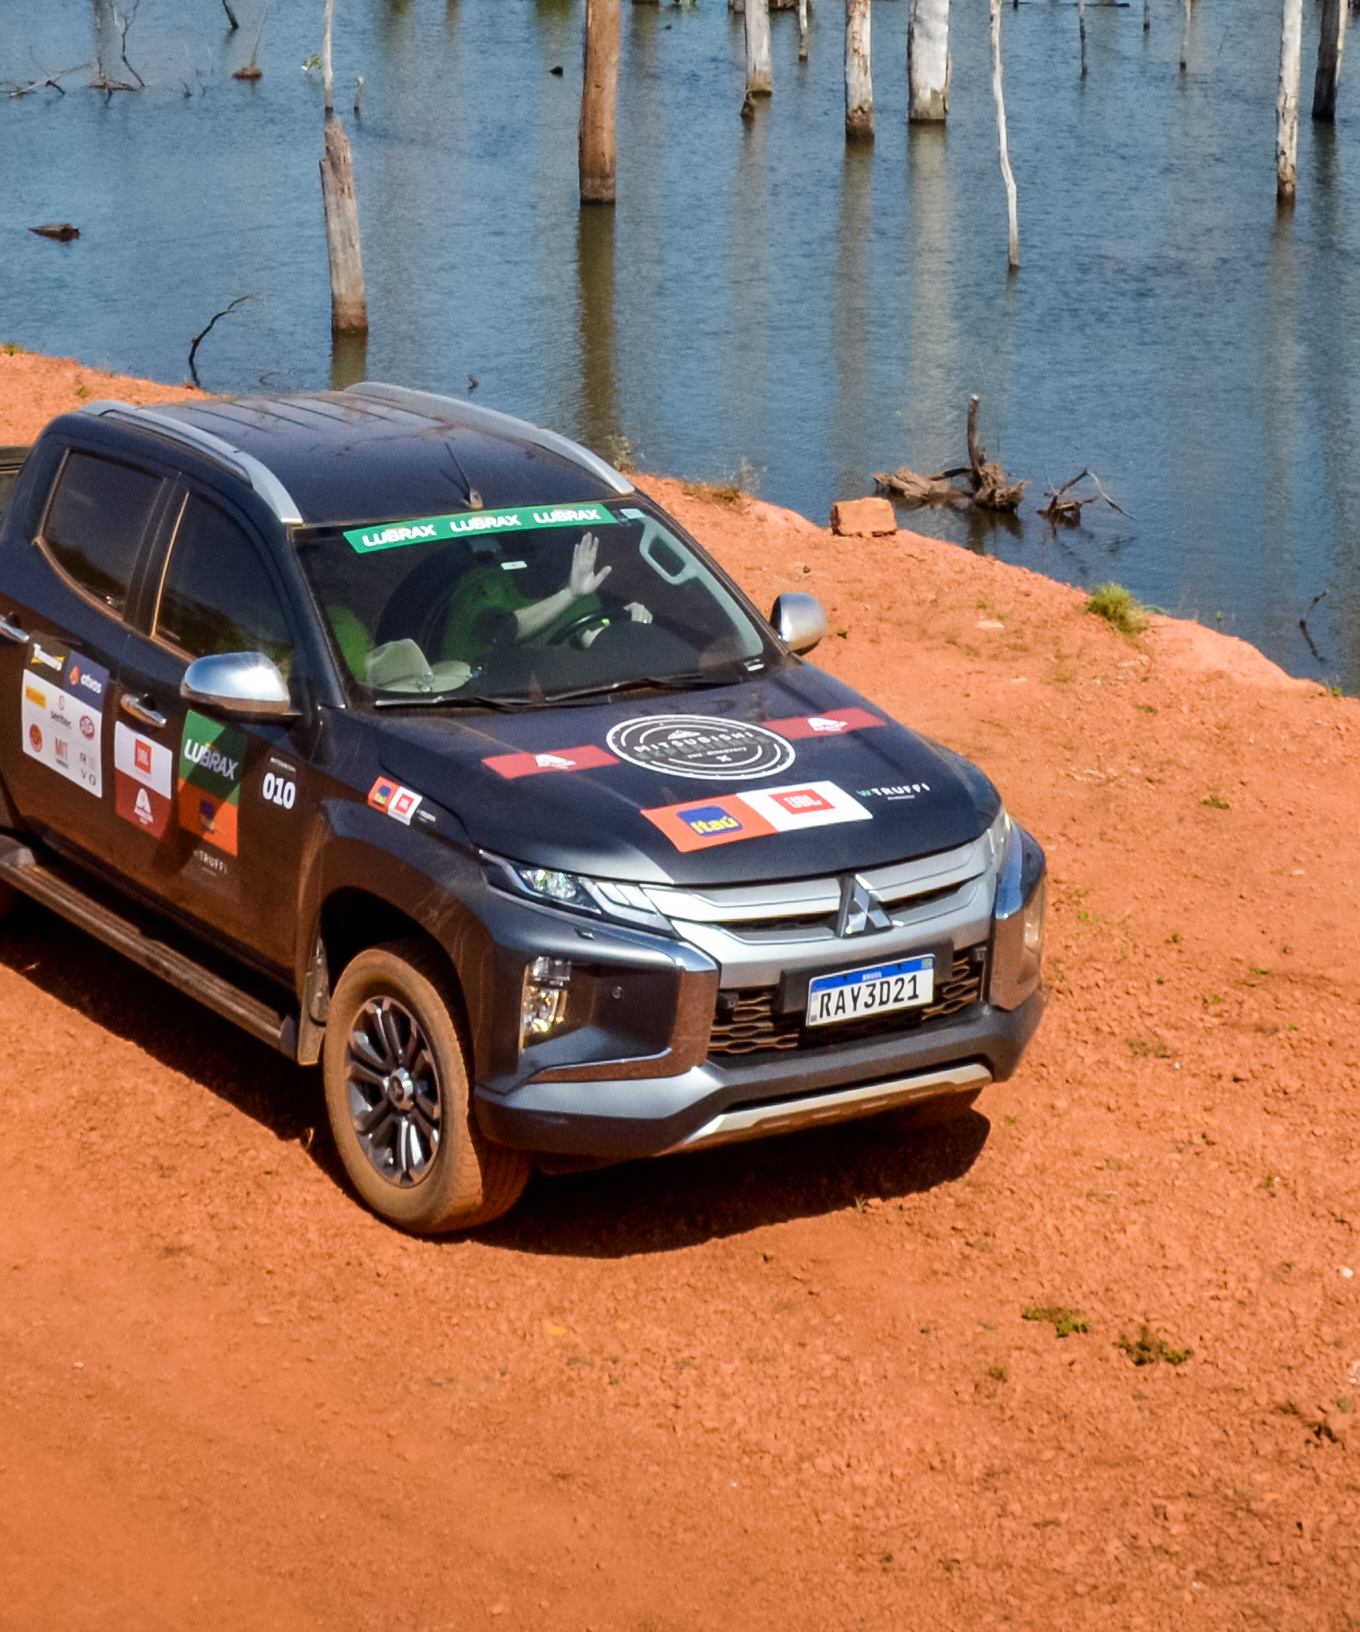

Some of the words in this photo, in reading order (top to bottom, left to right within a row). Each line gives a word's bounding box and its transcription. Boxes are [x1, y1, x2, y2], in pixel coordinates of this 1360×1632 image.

[362, 524, 437, 547] LUBRAX
[450, 514, 522, 533] LUBRAX
[533, 509, 601, 524] LUBRAX
[184, 739, 239, 780] LUBRAX
[634, 731, 754, 753] MITSUBISHI
[262, 772, 296, 809] 010
[783, 795, 823, 808] JBL
[690, 814, 740, 835] Itaú
[820, 974, 919, 1019] RAY3D21
